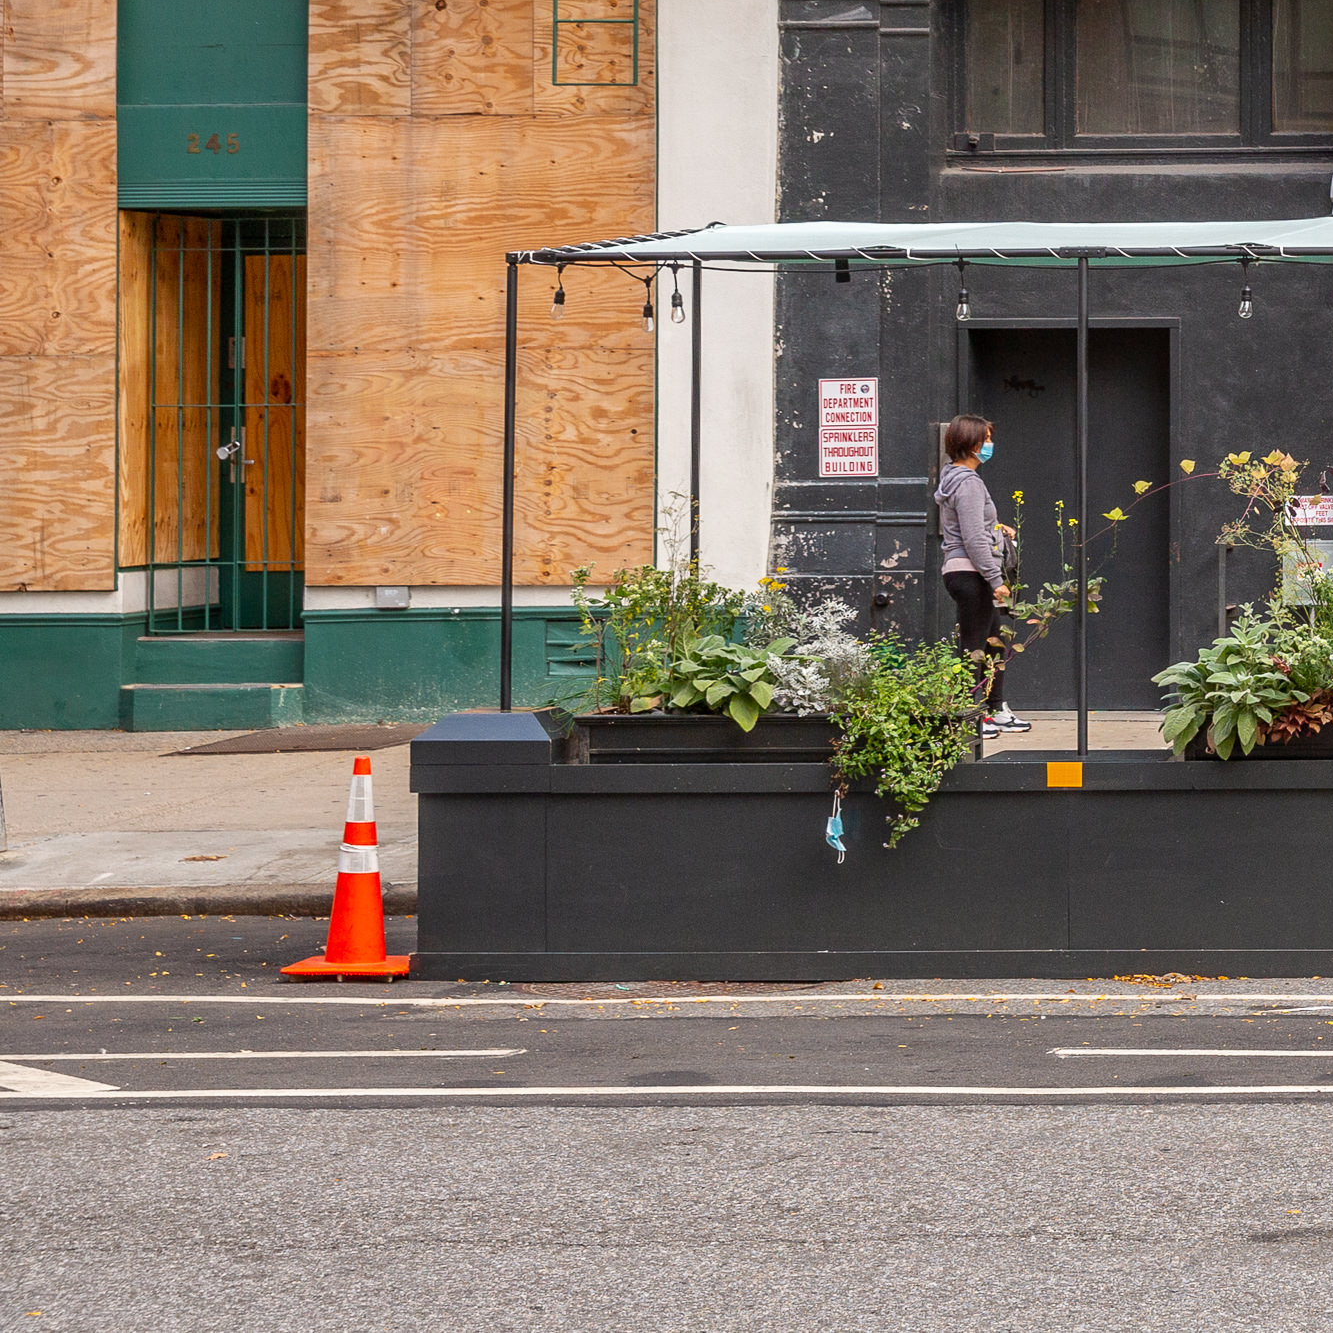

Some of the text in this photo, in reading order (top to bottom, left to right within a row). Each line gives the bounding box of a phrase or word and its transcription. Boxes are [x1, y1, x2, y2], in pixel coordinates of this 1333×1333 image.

[186, 132, 241, 155] 245
[839, 383, 857, 395] FIRE
[823, 397, 874, 409] DEPARTMENT
[825, 411, 873, 423] CONNECTION
[823, 431, 874, 443] SPRINKLERS
[823, 446, 874, 458] THROUGHOUT
[825, 461, 873, 472] BUILDING
